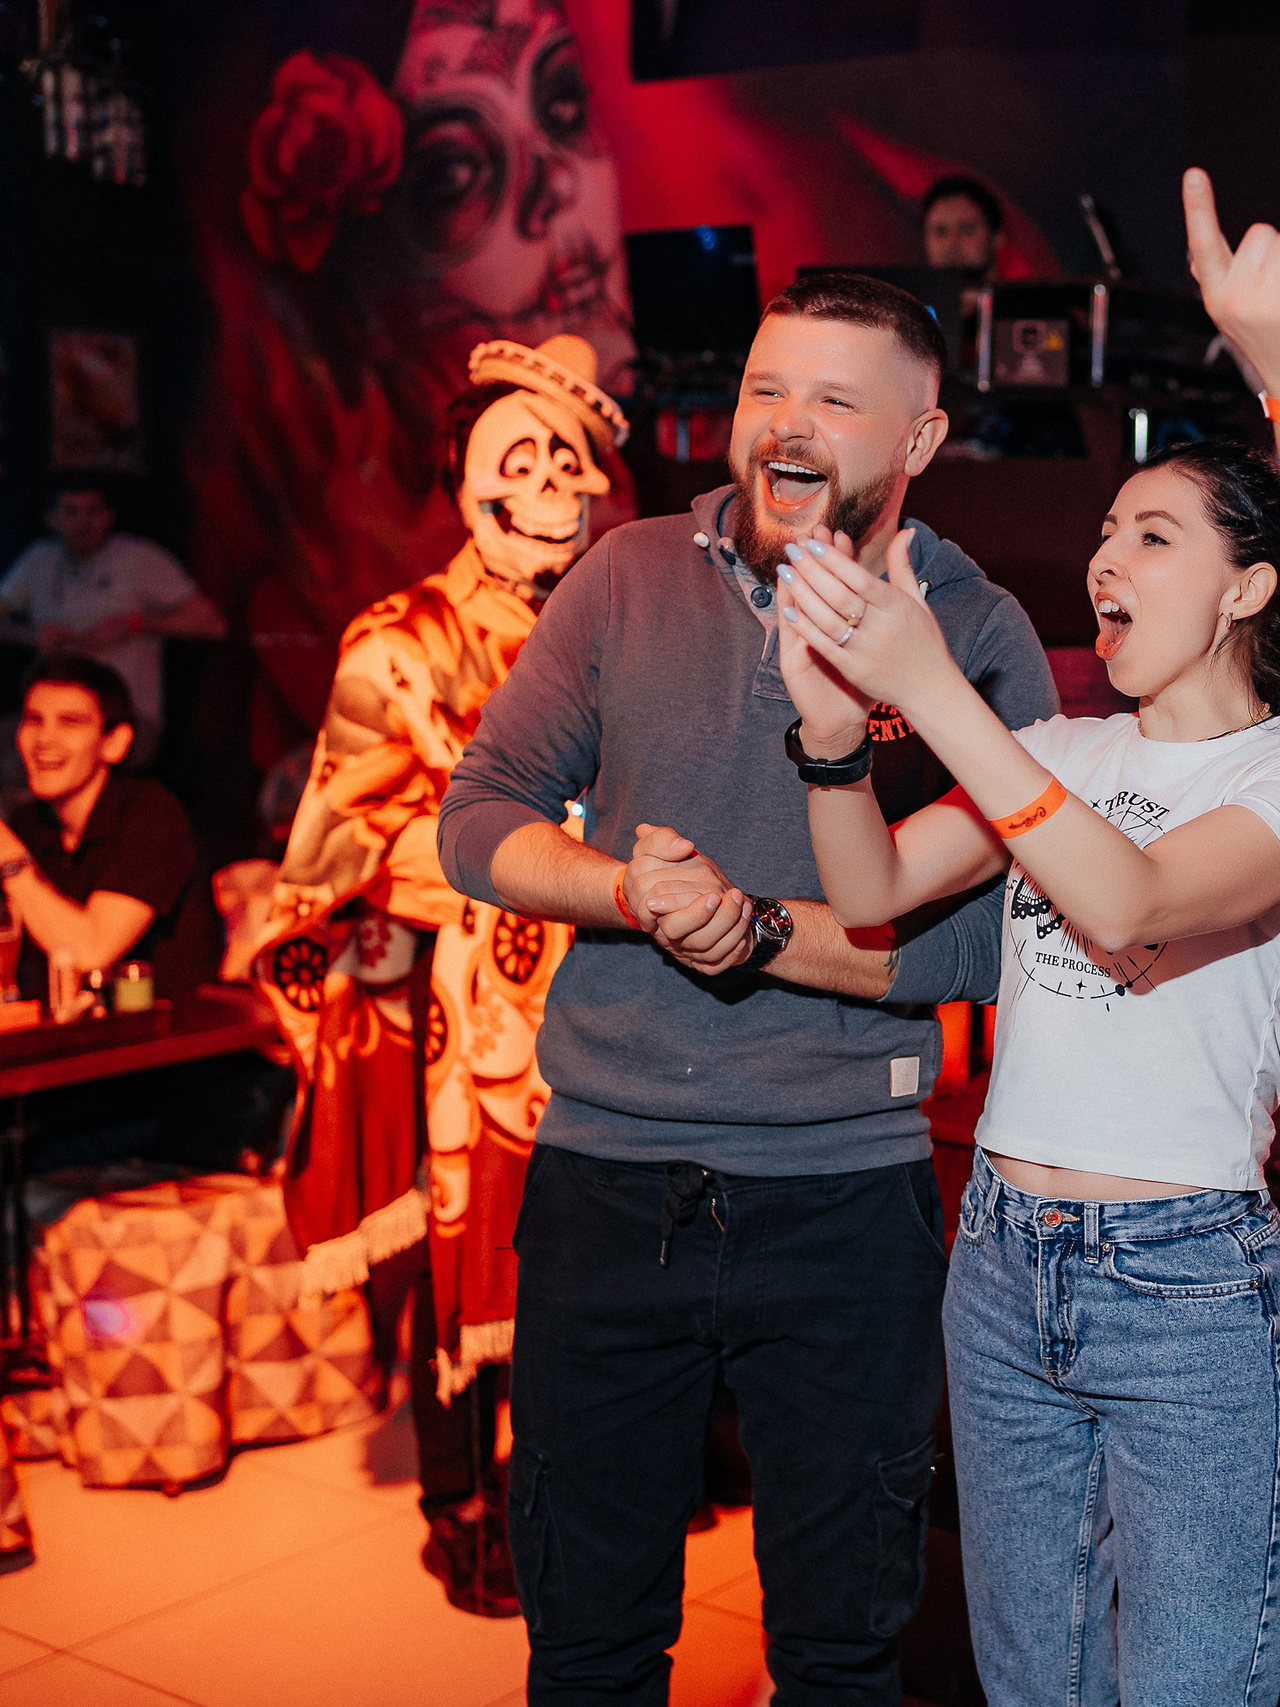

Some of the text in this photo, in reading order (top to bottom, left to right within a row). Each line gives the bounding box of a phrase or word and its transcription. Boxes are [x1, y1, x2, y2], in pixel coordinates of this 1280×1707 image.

[1105, 791, 1170, 820] TRUST
[1035, 952, 1111, 978] THE PROCESS
